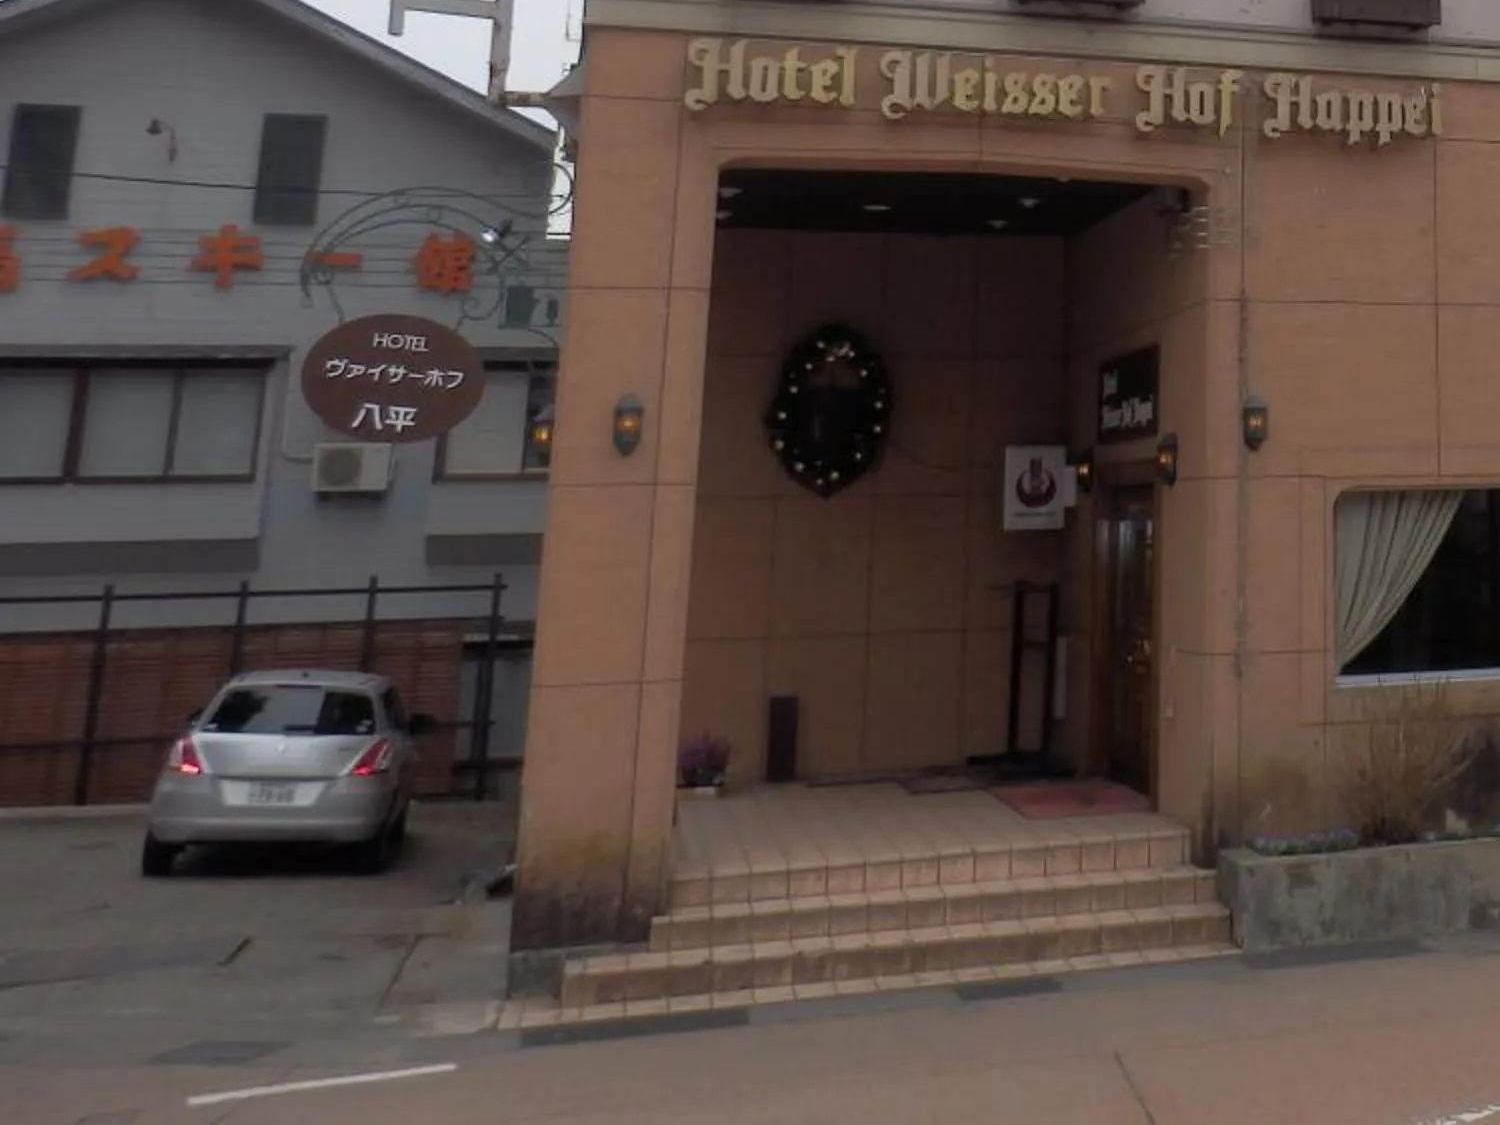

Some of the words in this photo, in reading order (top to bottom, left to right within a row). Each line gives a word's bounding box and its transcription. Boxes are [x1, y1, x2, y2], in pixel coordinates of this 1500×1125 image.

[684, 35, 858, 112] Hotel
[880, 49, 1111, 120] Weisser
[1136, 65, 1244, 139] Hof
[1263, 72, 1444, 146] Happei
[372, 332, 429, 352] HOTEL
[325, 358, 465, 389] ヴァイサーホフ
[351, 402, 419, 433] 八平
